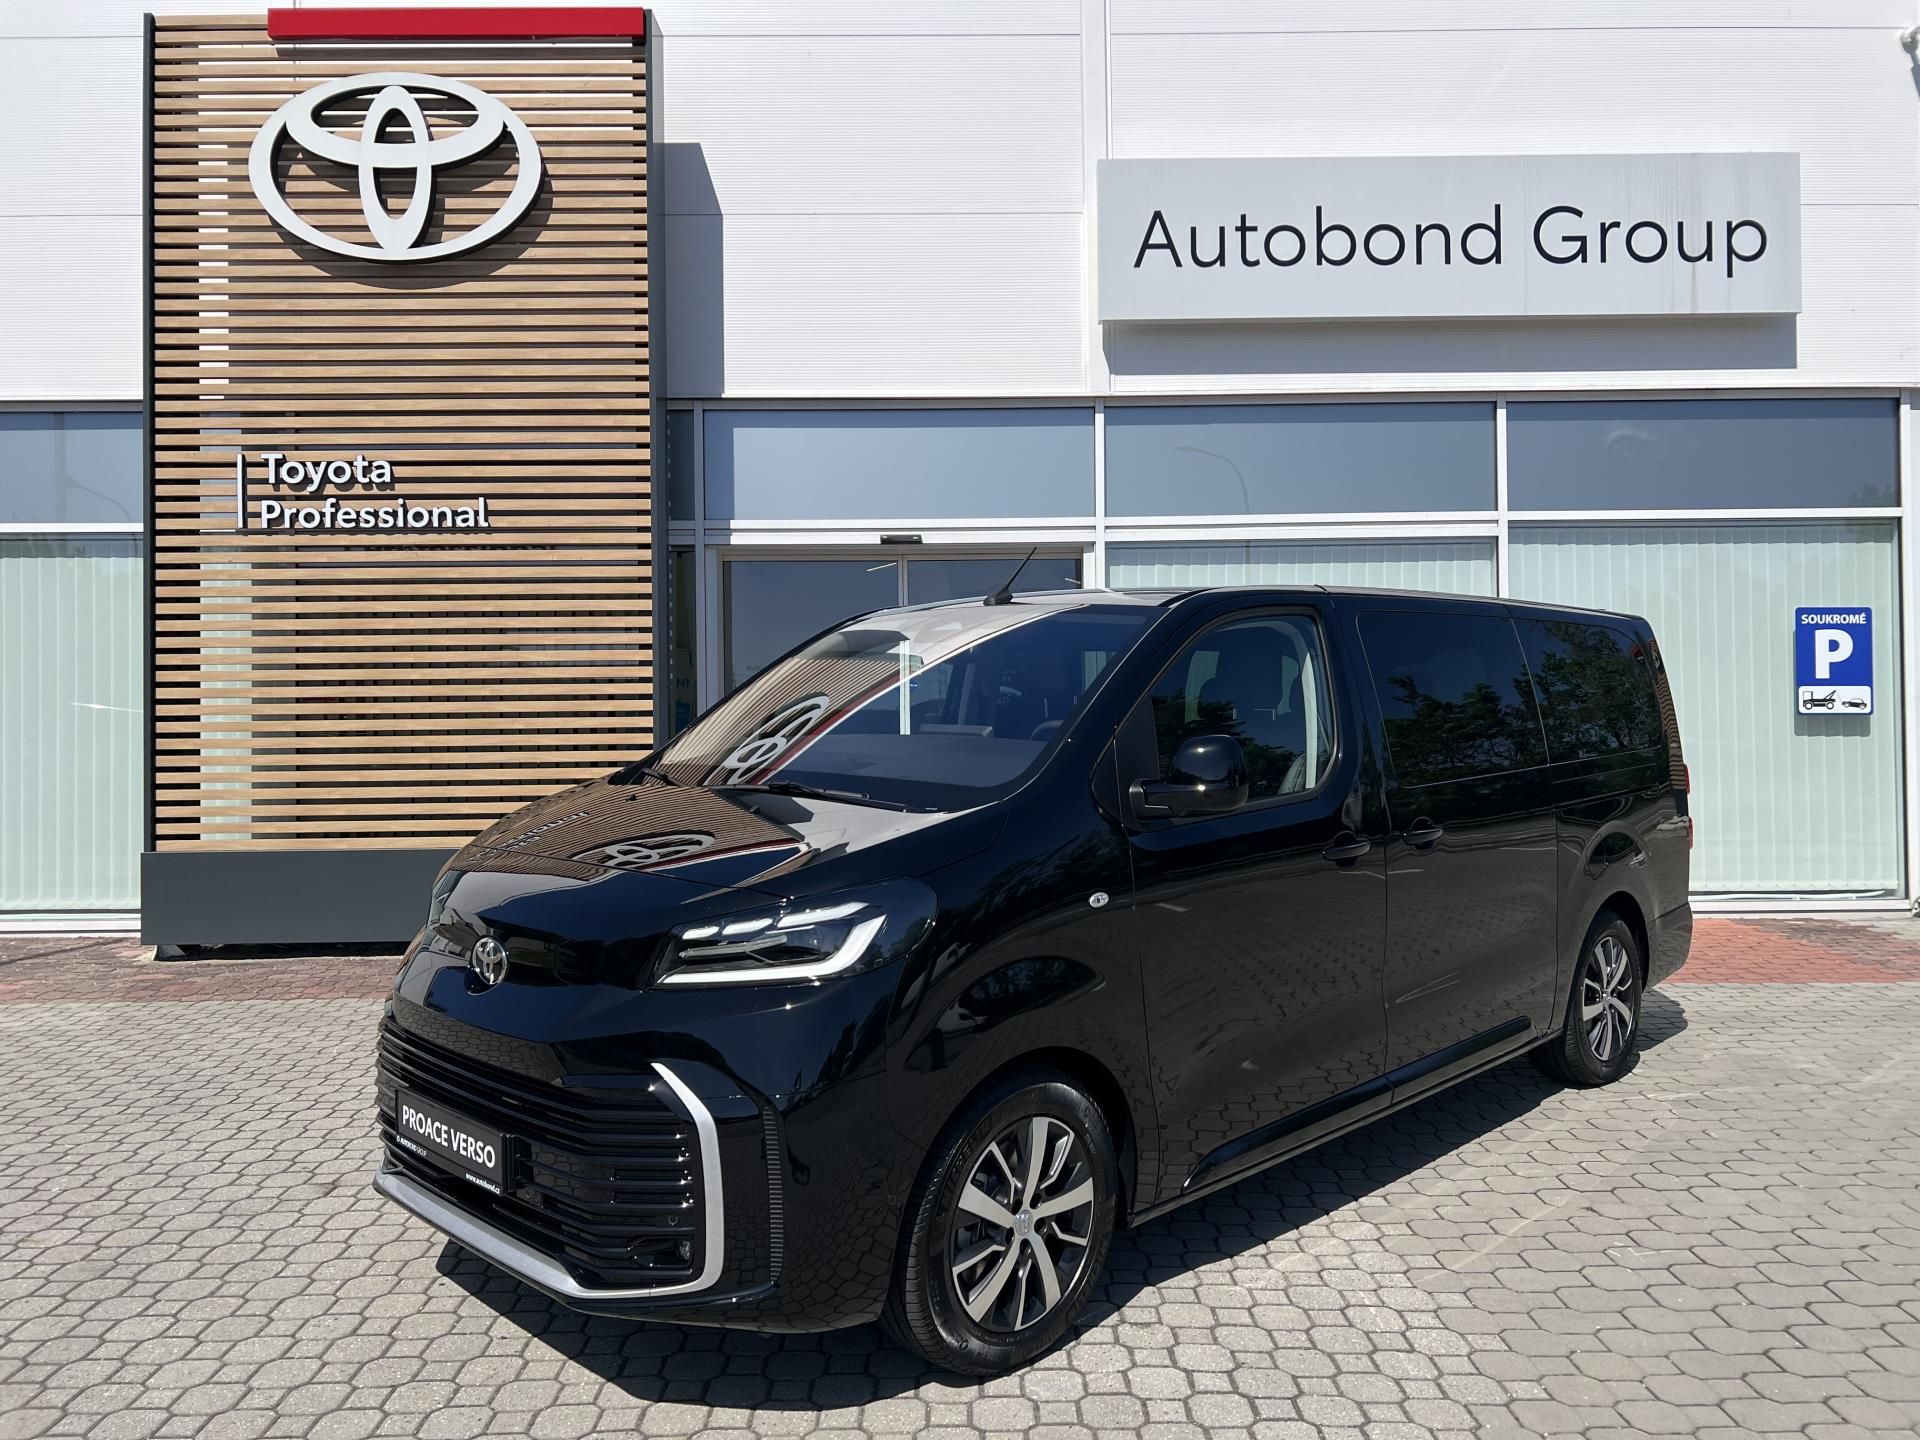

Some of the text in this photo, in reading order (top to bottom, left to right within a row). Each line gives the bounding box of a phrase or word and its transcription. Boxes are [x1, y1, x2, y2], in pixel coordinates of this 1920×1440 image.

[1133, 203, 1769, 279] Autobond Group
[260, 453, 392, 493] Toyota
[260, 496, 489, 529] Professional
[1801, 612, 1867, 625] SOUKROMÉ
[1814, 628, 1854, 679] P
[402, 1104, 496, 1169] PROACE VERSO
